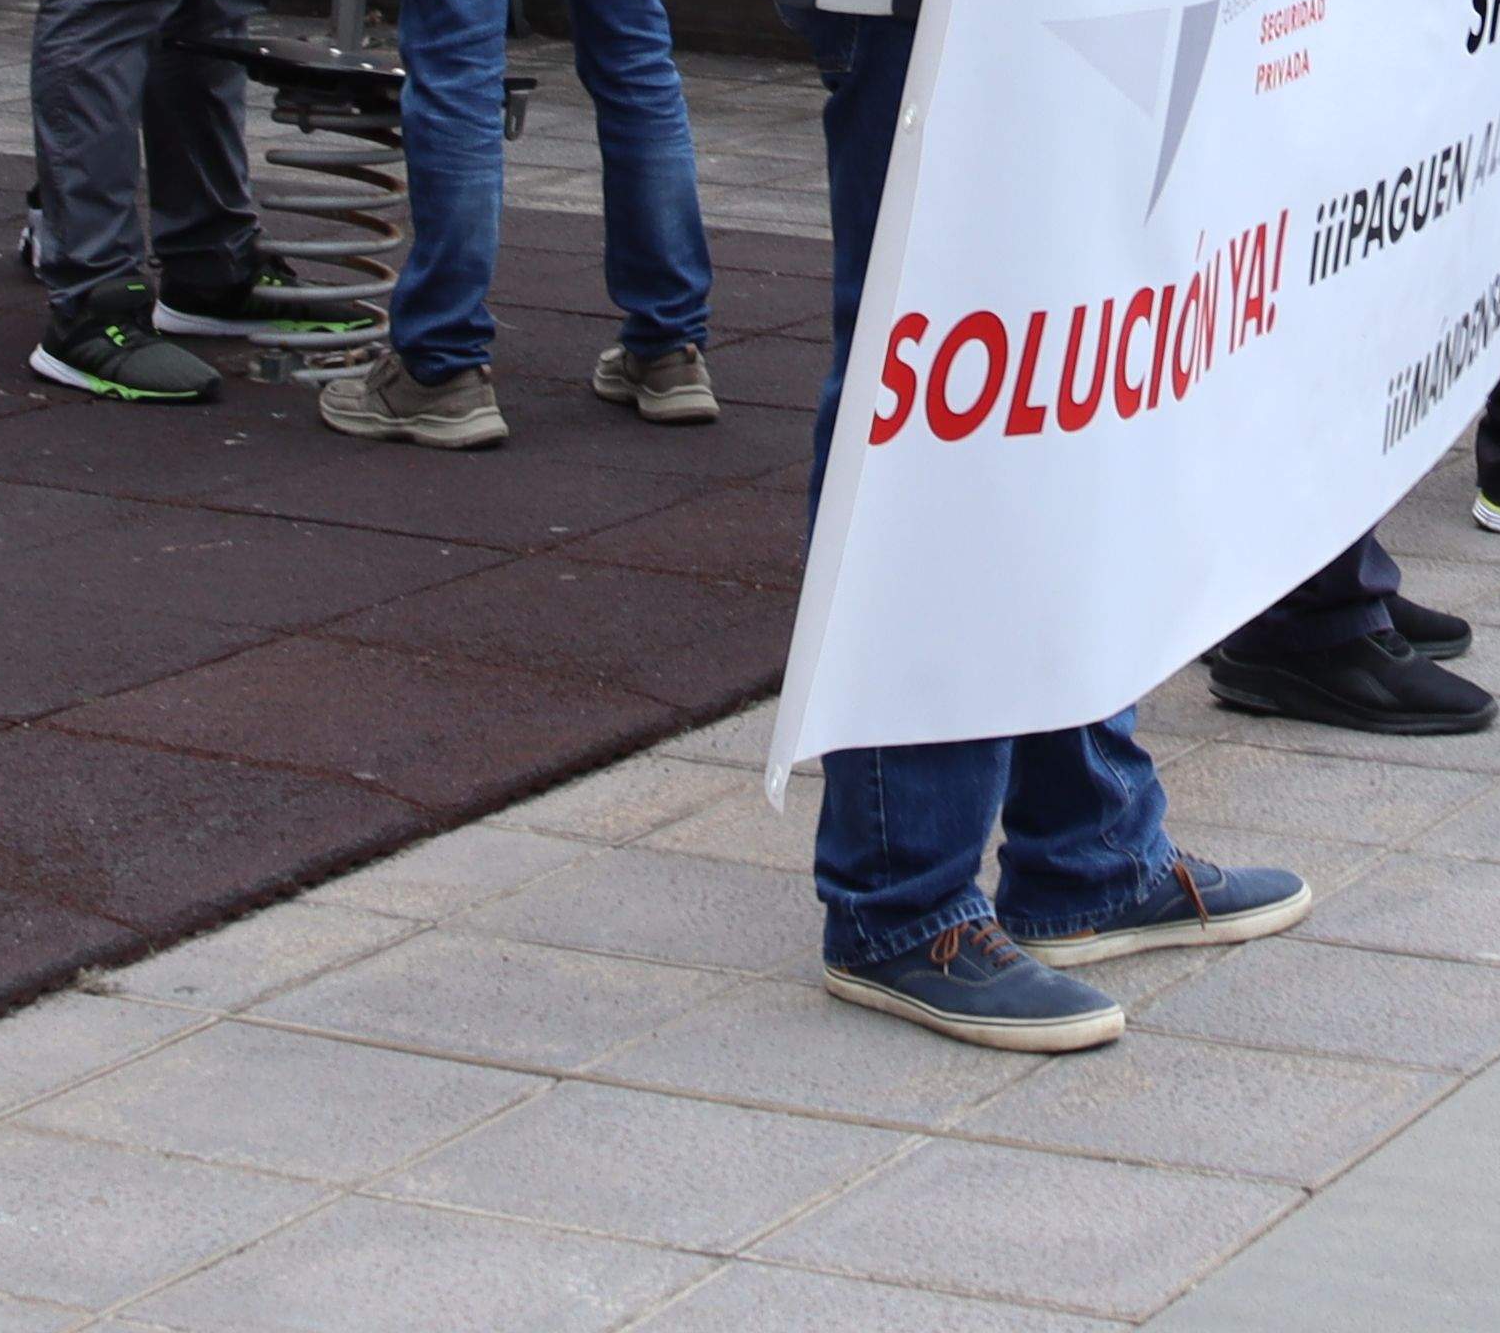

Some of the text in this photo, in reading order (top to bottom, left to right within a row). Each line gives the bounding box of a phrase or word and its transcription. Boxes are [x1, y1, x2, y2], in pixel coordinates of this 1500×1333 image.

[1255, 48, 1310, 95] PRIVADA
[869, 209, 1288, 446] SOLUCIÓN YA!
